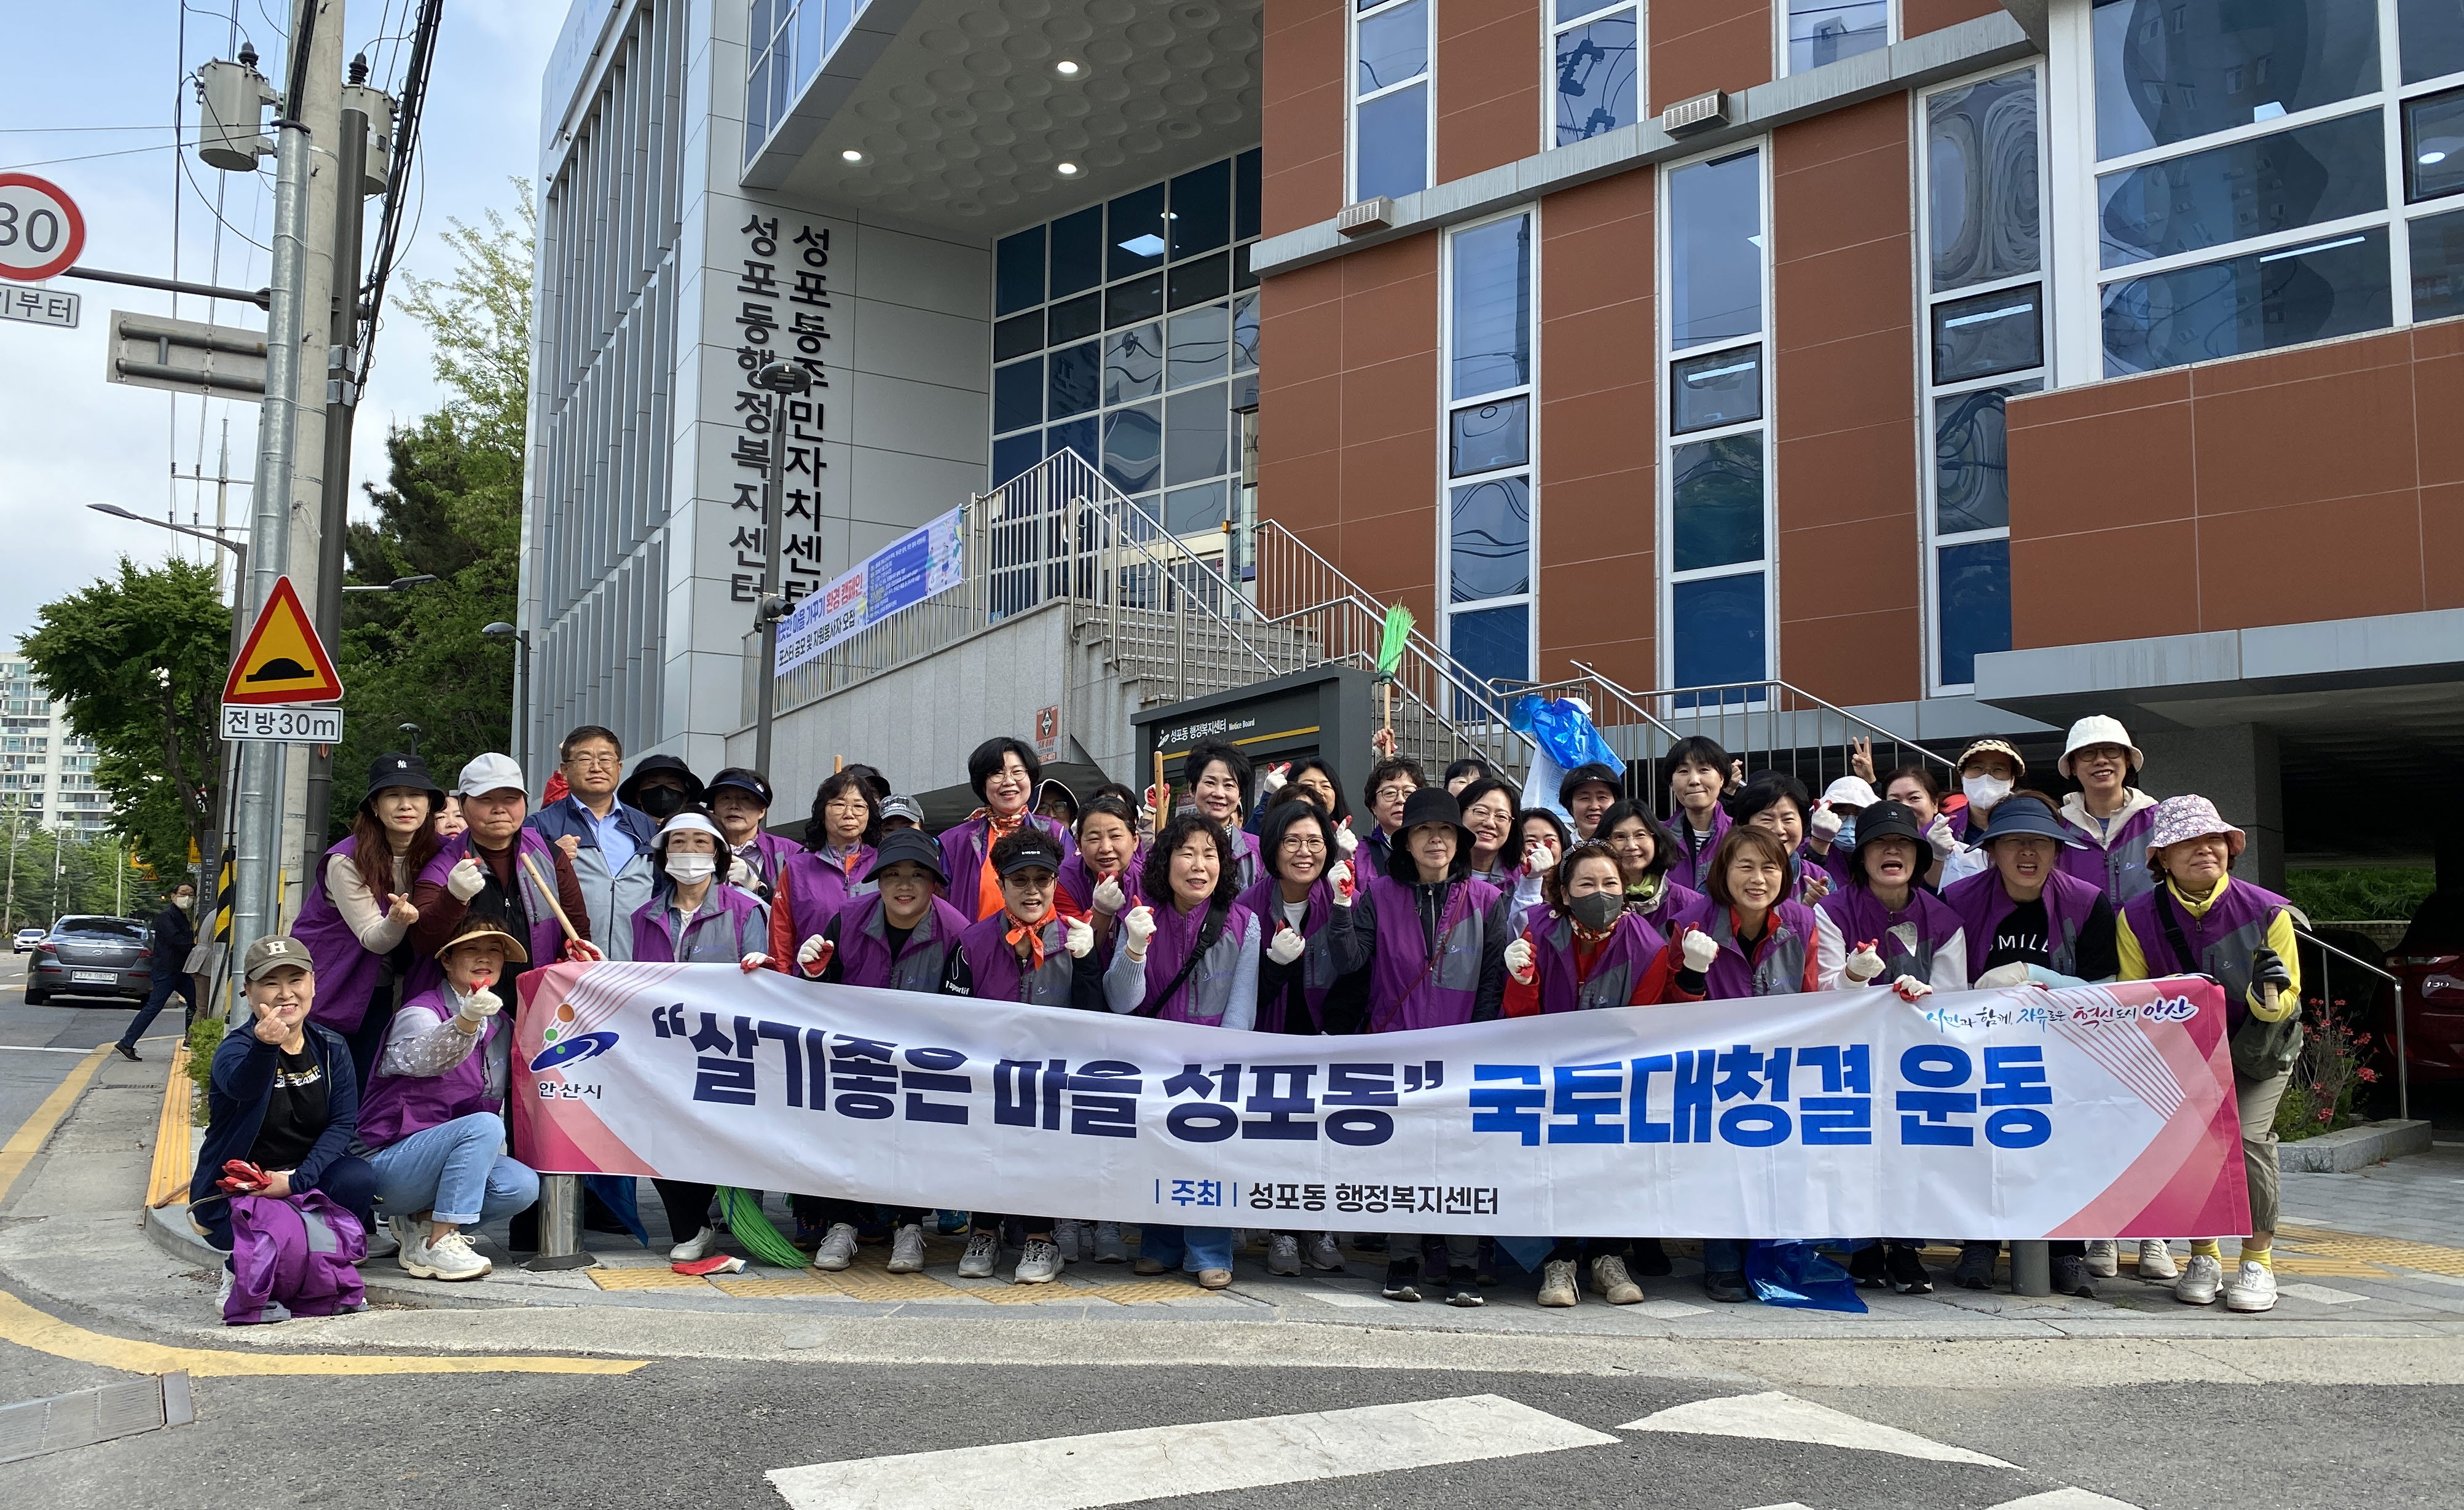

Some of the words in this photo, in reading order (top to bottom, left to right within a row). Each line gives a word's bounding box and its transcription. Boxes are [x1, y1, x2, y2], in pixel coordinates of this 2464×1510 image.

[776, 617, 793, 643] 끗한
[793, 607, 805, 634] 마을
[806, 594, 825, 626] 가꾸기
[826, 588, 840, 615] 환경
[841, 571, 863, 605] 캠페인
[779, 643, 794, 667] 포스터
[795, 637, 805, 658] 공모
[806, 634, 813, 653] 및
[813, 616, 842, 647] 자원봉사자
[843, 607, 856, 632] 모집
[1170, 726, 1189, 743] 성포동
[1189, 718, 1227, 739] 행정복지센터
[1229, 722, 1242, 731] Notice
[1242, 717, 1255, 728] Board
[266, 940, 289, 956] H
[1989, 934, 2049, 953] MILE
[1926, 1007, 1977, 1034] 시민과
[2016, 1007, 2066, 1033] 자유로운
[2072, 1005, 2138, 1031] 혁신도시
[2143, 997, 2198, 1022] 안산
[539, 1082, 602, 1099] 안산시
[993, 1058, 1143, 1139] 마을
[1469, 1044, 1872, 1148] 국토대청결
[1895, 1044, 2053, 1149] 운동
[1171, 1179, 1221, 1207] 주최
[1249, 1182, 1327, 1212] 성포동
[1336, 1183, 1498, 1215] 행정복지센터
